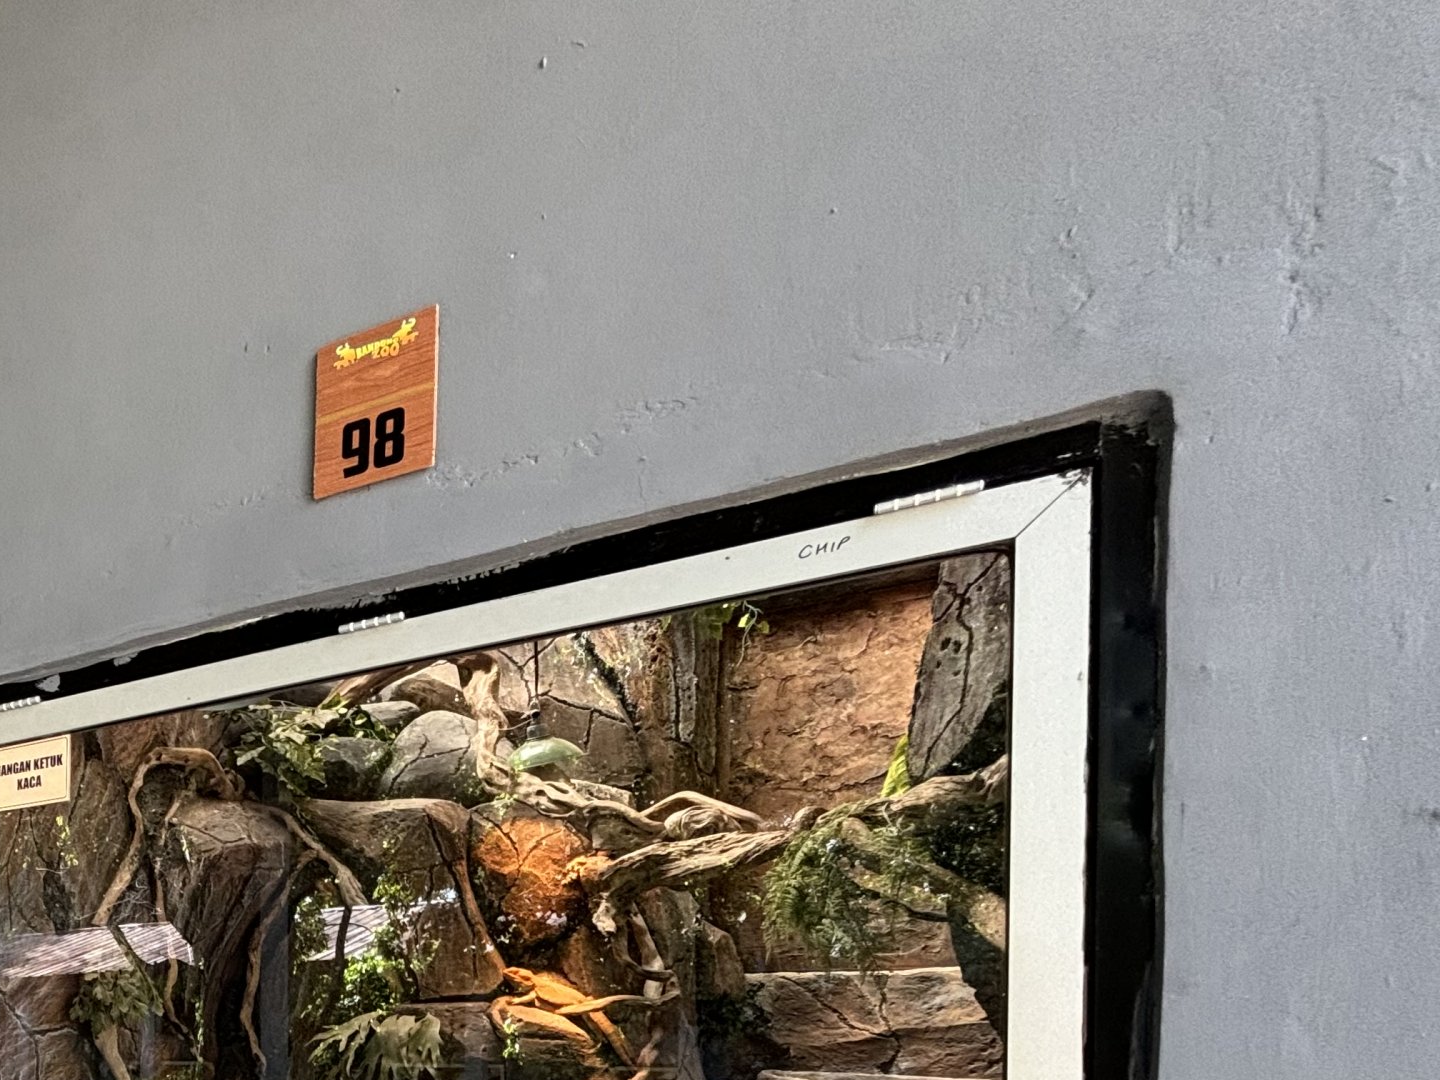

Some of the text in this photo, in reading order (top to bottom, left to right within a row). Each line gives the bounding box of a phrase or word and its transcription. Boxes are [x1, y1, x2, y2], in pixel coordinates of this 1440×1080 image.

[372, 343, 400, 359] ZOO
[342, 407, 405, 479] 98
[798, 535, 851, 559] CHIP
[33, 754, 63, 770] KETUK
[17, 775, 41, 790] KACA
